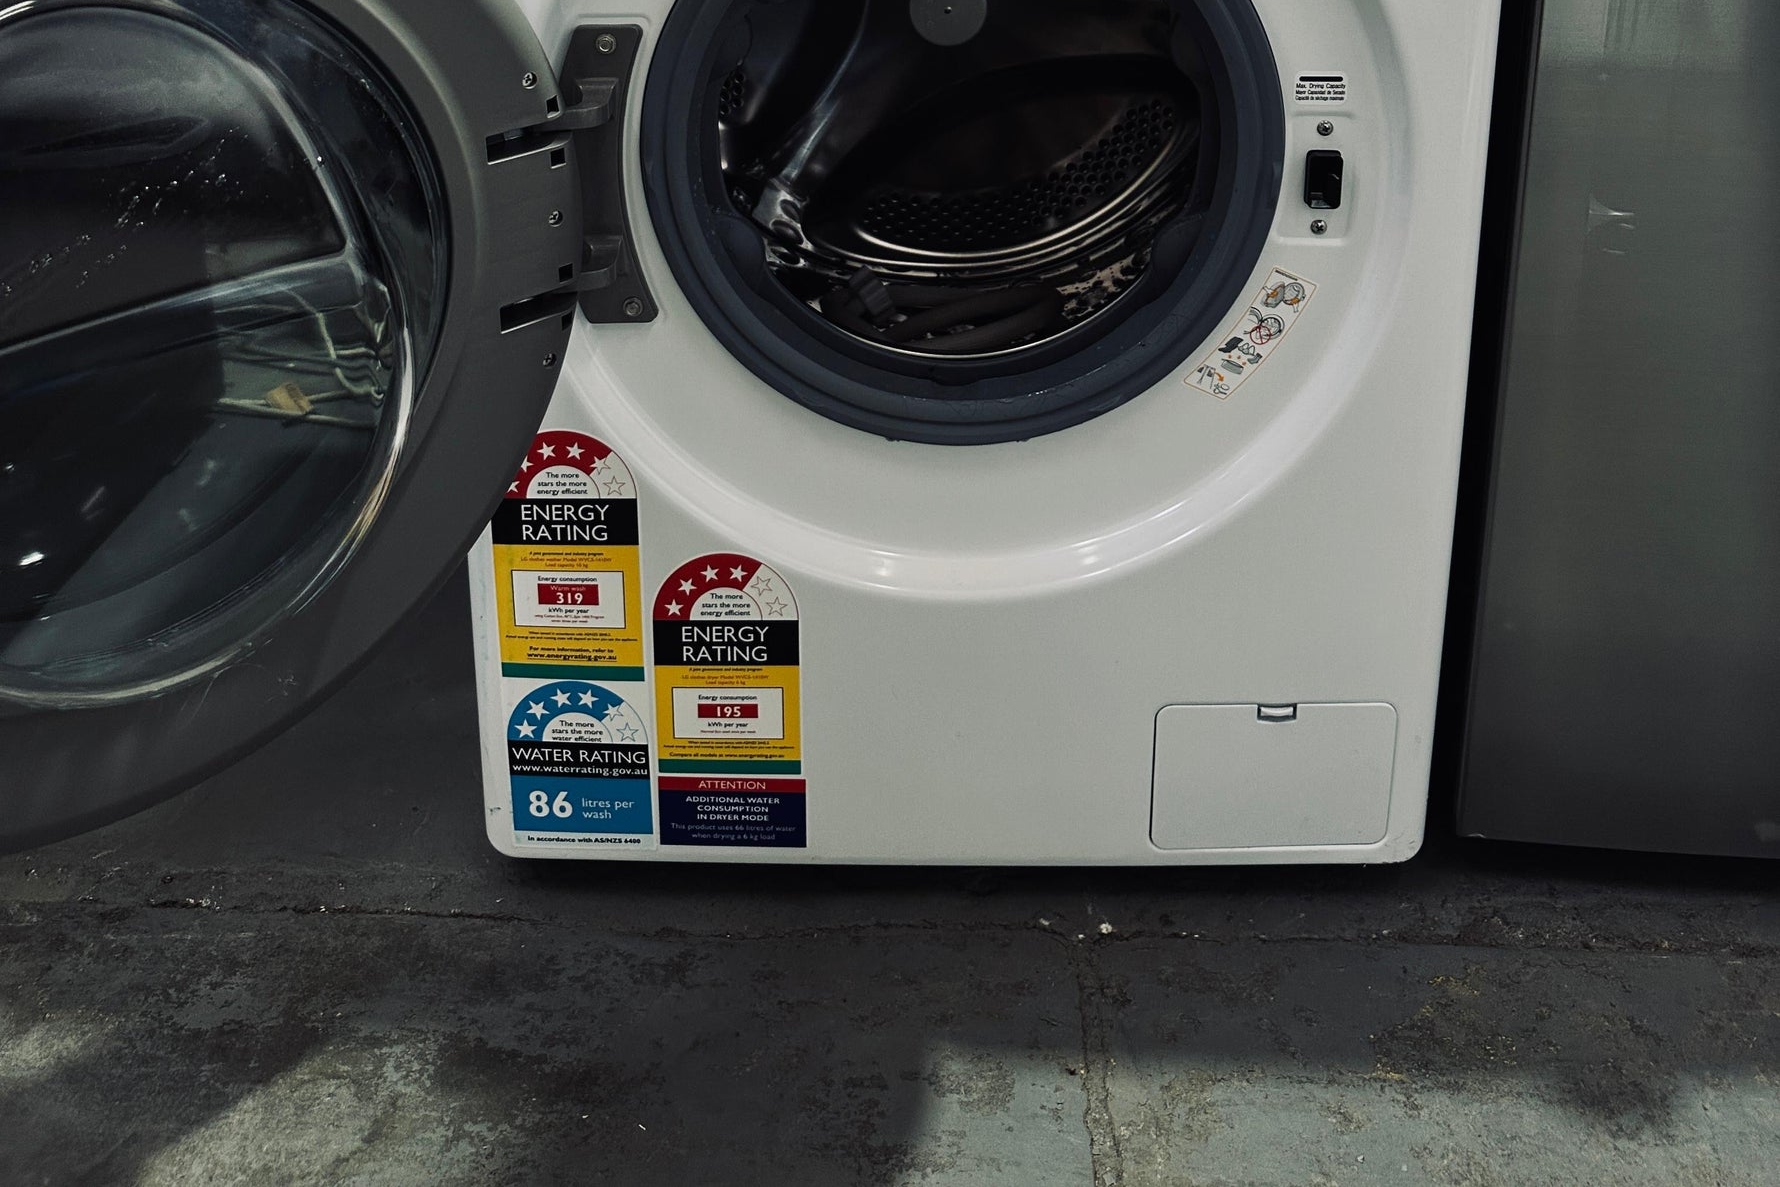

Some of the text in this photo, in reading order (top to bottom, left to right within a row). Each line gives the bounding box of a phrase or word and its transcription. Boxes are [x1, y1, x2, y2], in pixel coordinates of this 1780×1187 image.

[546, 471, 559, 479] The
[537, 488, 560, 496] energy
[521, 504, 610, 521] ENERGY
[522, 524, 608, 541] RATING
[538, 575, 598, 583] Energy consumption
[556, 592, 584, 604] 319
[710, 592, 723, 600] The
[700, 610, 723, 618] energy
[681, 626, 769, 642] ENERGY
[683, 645, 768, 662] RATING
[698, 694, 758, 702] Energy consumption
[716, 705, 742, 718] 195
[559, 720, 574, 728] The
[511, 747, 646, 764] WATER RATING
[512, 764, 648, 776] www.waterrating.gov.au
[698, 780, 766, 790] ATTENTION
[528, 790, 573, 818] 86
[582, 797, 635, 810] litres per
[685, 795, 746, 804] ADDITIONAL
[582, 809, 612, 819] wash
[696, 805, 769, 813] CONSUMPTION
[670, 822, 686, 830] This
[687, 823, 716, 832] product
[536, 835, 576, 843] accordance
[759, 833, 776, 841] load
